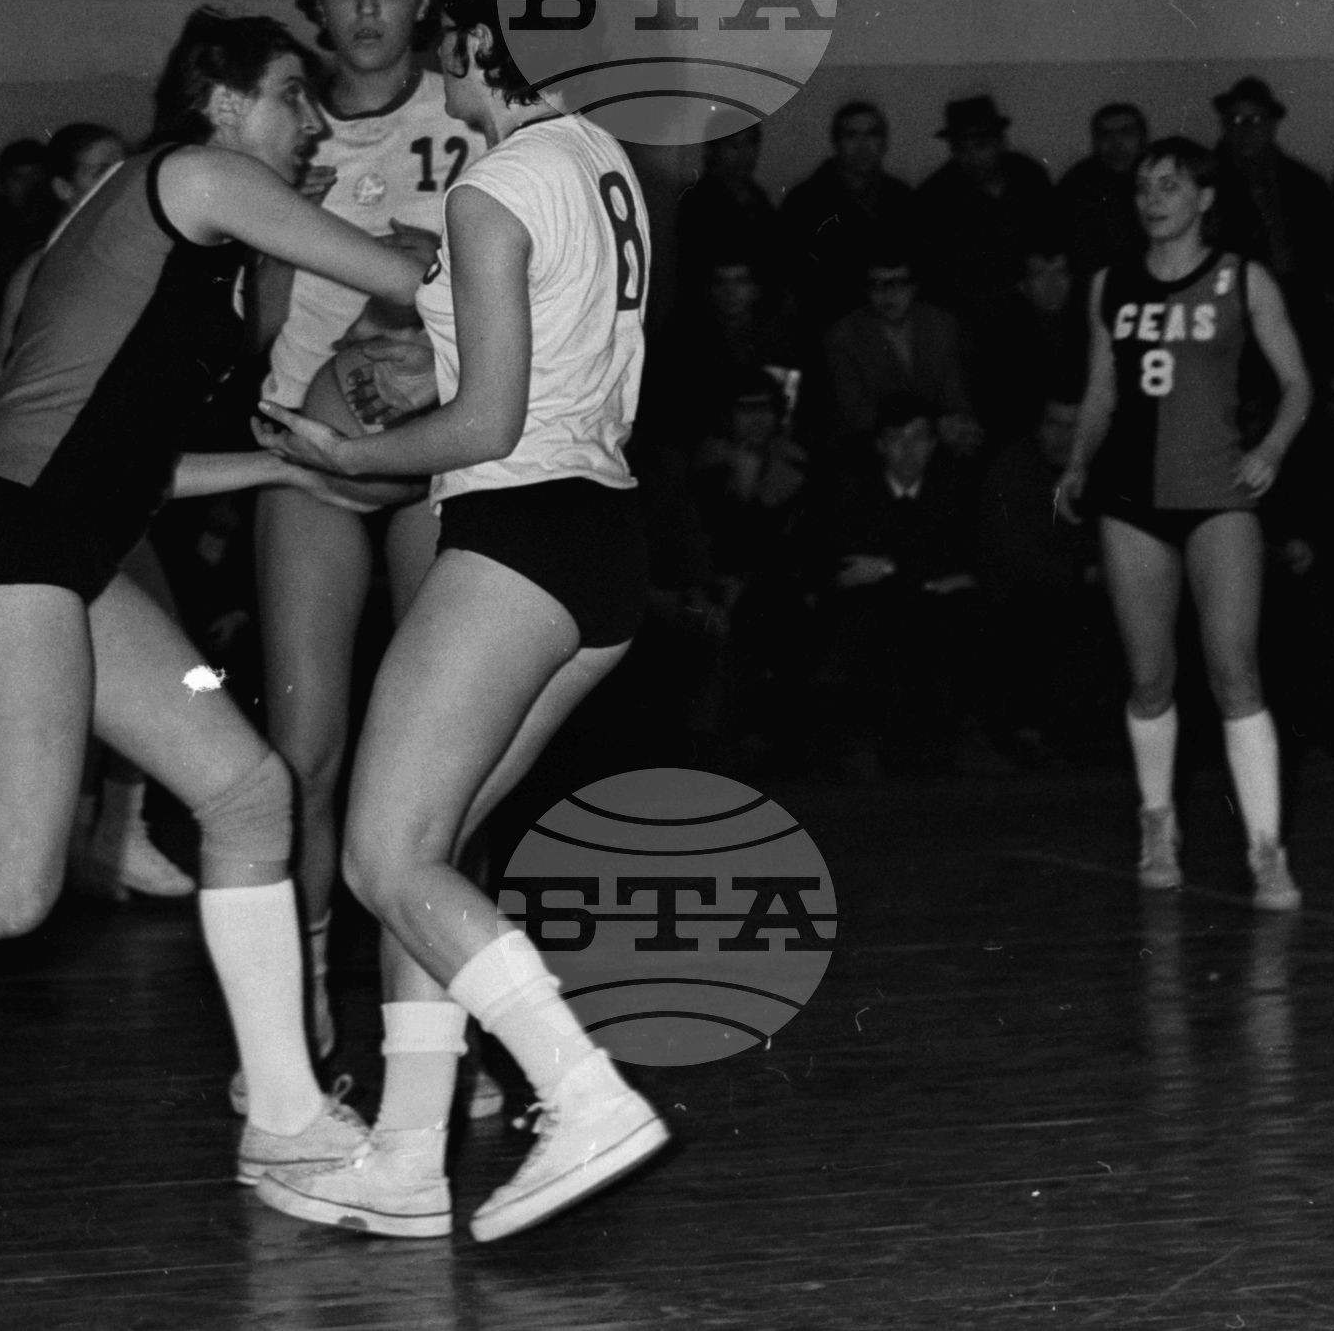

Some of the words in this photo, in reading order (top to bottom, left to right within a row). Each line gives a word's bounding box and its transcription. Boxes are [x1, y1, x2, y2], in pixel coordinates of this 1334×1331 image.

[410, 136, 468, 192] 12
[599, 170, 645, 311] 8
[1113, 303, 1216, 341] GEAS
[1140, 349, 1175, 396] 8
